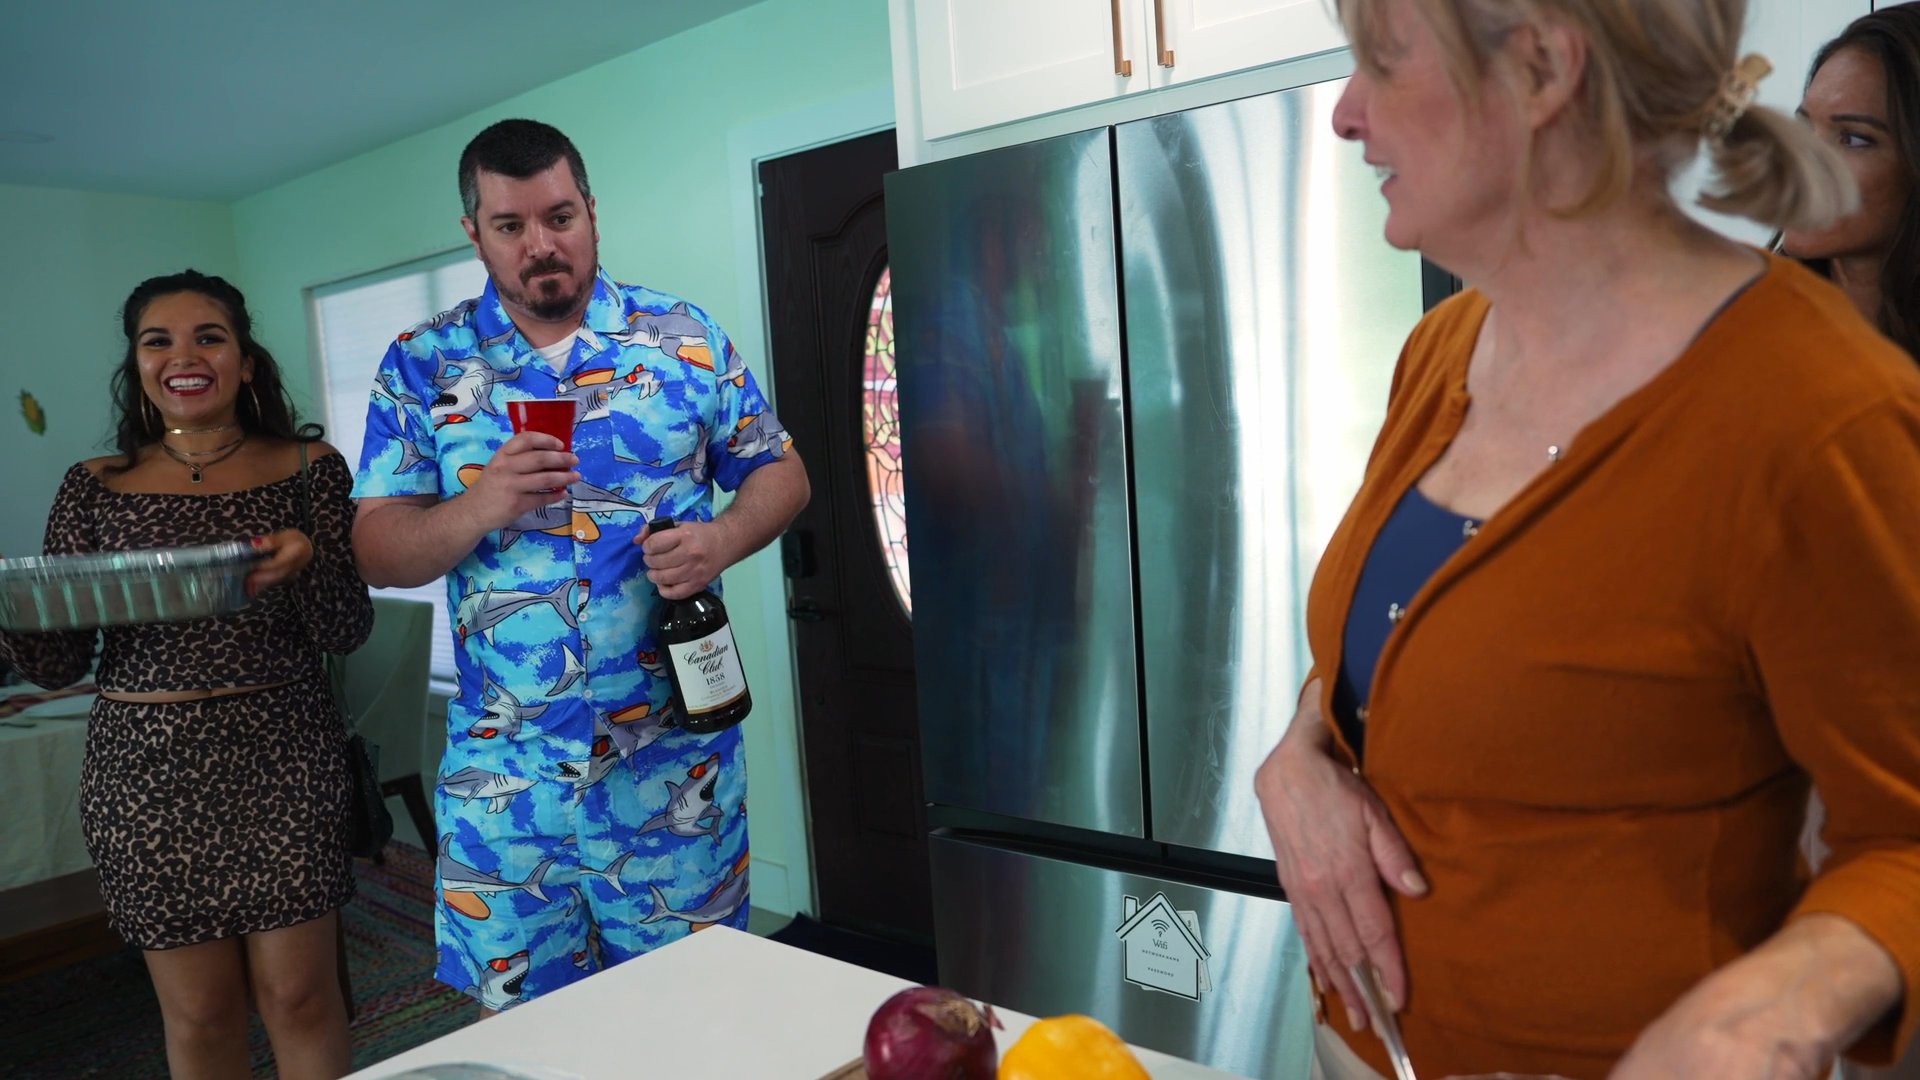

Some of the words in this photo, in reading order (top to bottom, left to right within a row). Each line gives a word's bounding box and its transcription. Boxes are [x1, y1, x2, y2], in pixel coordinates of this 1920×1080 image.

[684, 644, 728, 665] Canadian
[698, 657, 724, 675] Club
[706, 673, 725, 686] 1858
